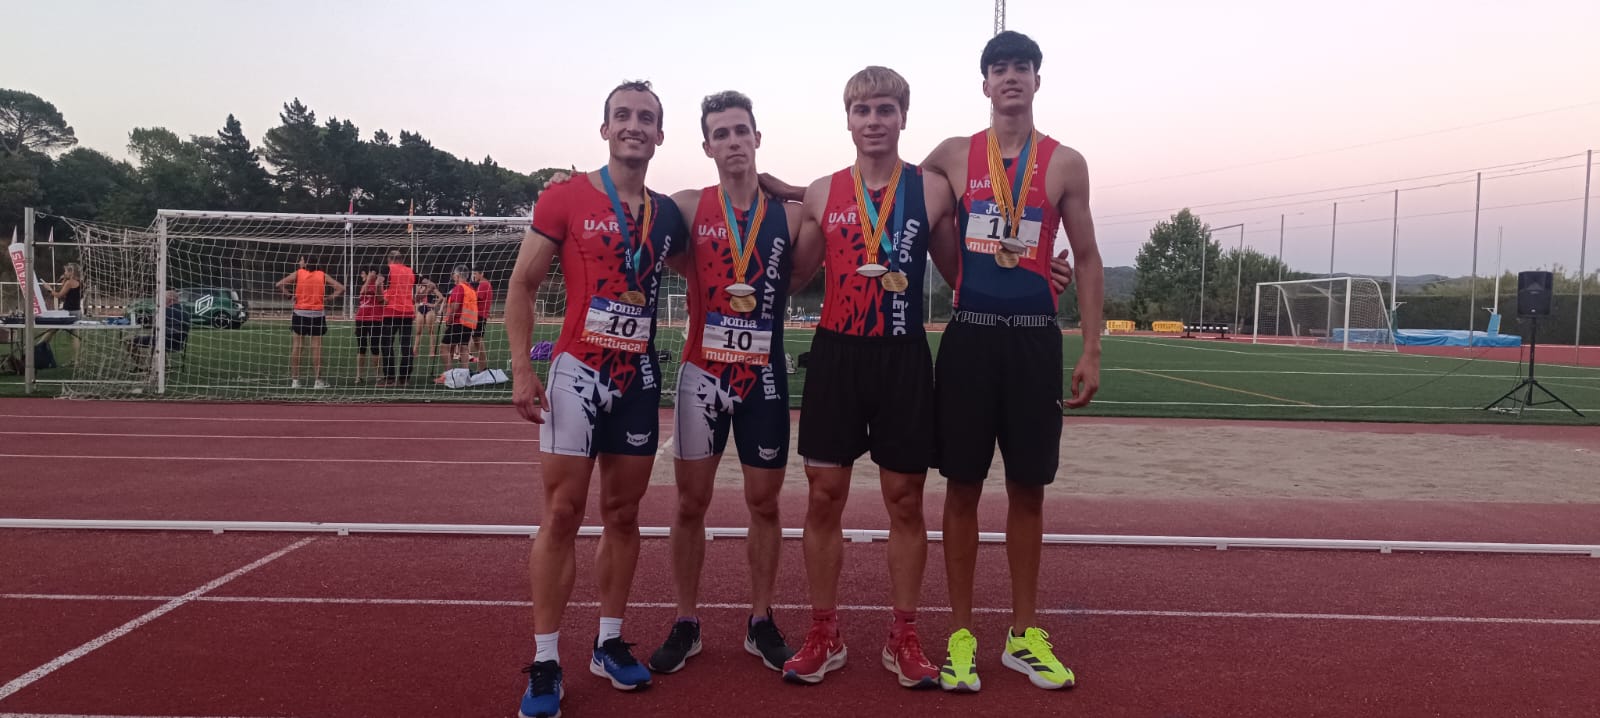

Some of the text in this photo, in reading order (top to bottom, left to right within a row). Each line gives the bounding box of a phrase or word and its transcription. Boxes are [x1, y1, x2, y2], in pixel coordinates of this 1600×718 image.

[970, 179, 991, 189] UAR
[985, 203, 1026, 217] Jo
[828, 212, 857, 224] UAR
[584, 219, 620, 232] UAR
[698, 225, 727, 238] UAR
[899, 218, 921, 264] UNIÓ
[766, 237, 785, 280] UNIÓ
[606, 301, 642, 315] Joma
[605, 315, 638, 338] 10
[720, 315, 758, 329] Joma
[723, 329, 753, 351] 10
[705, 350, 765, 366] mutuacat
[640, 353, 657, 391] RUBÍ
